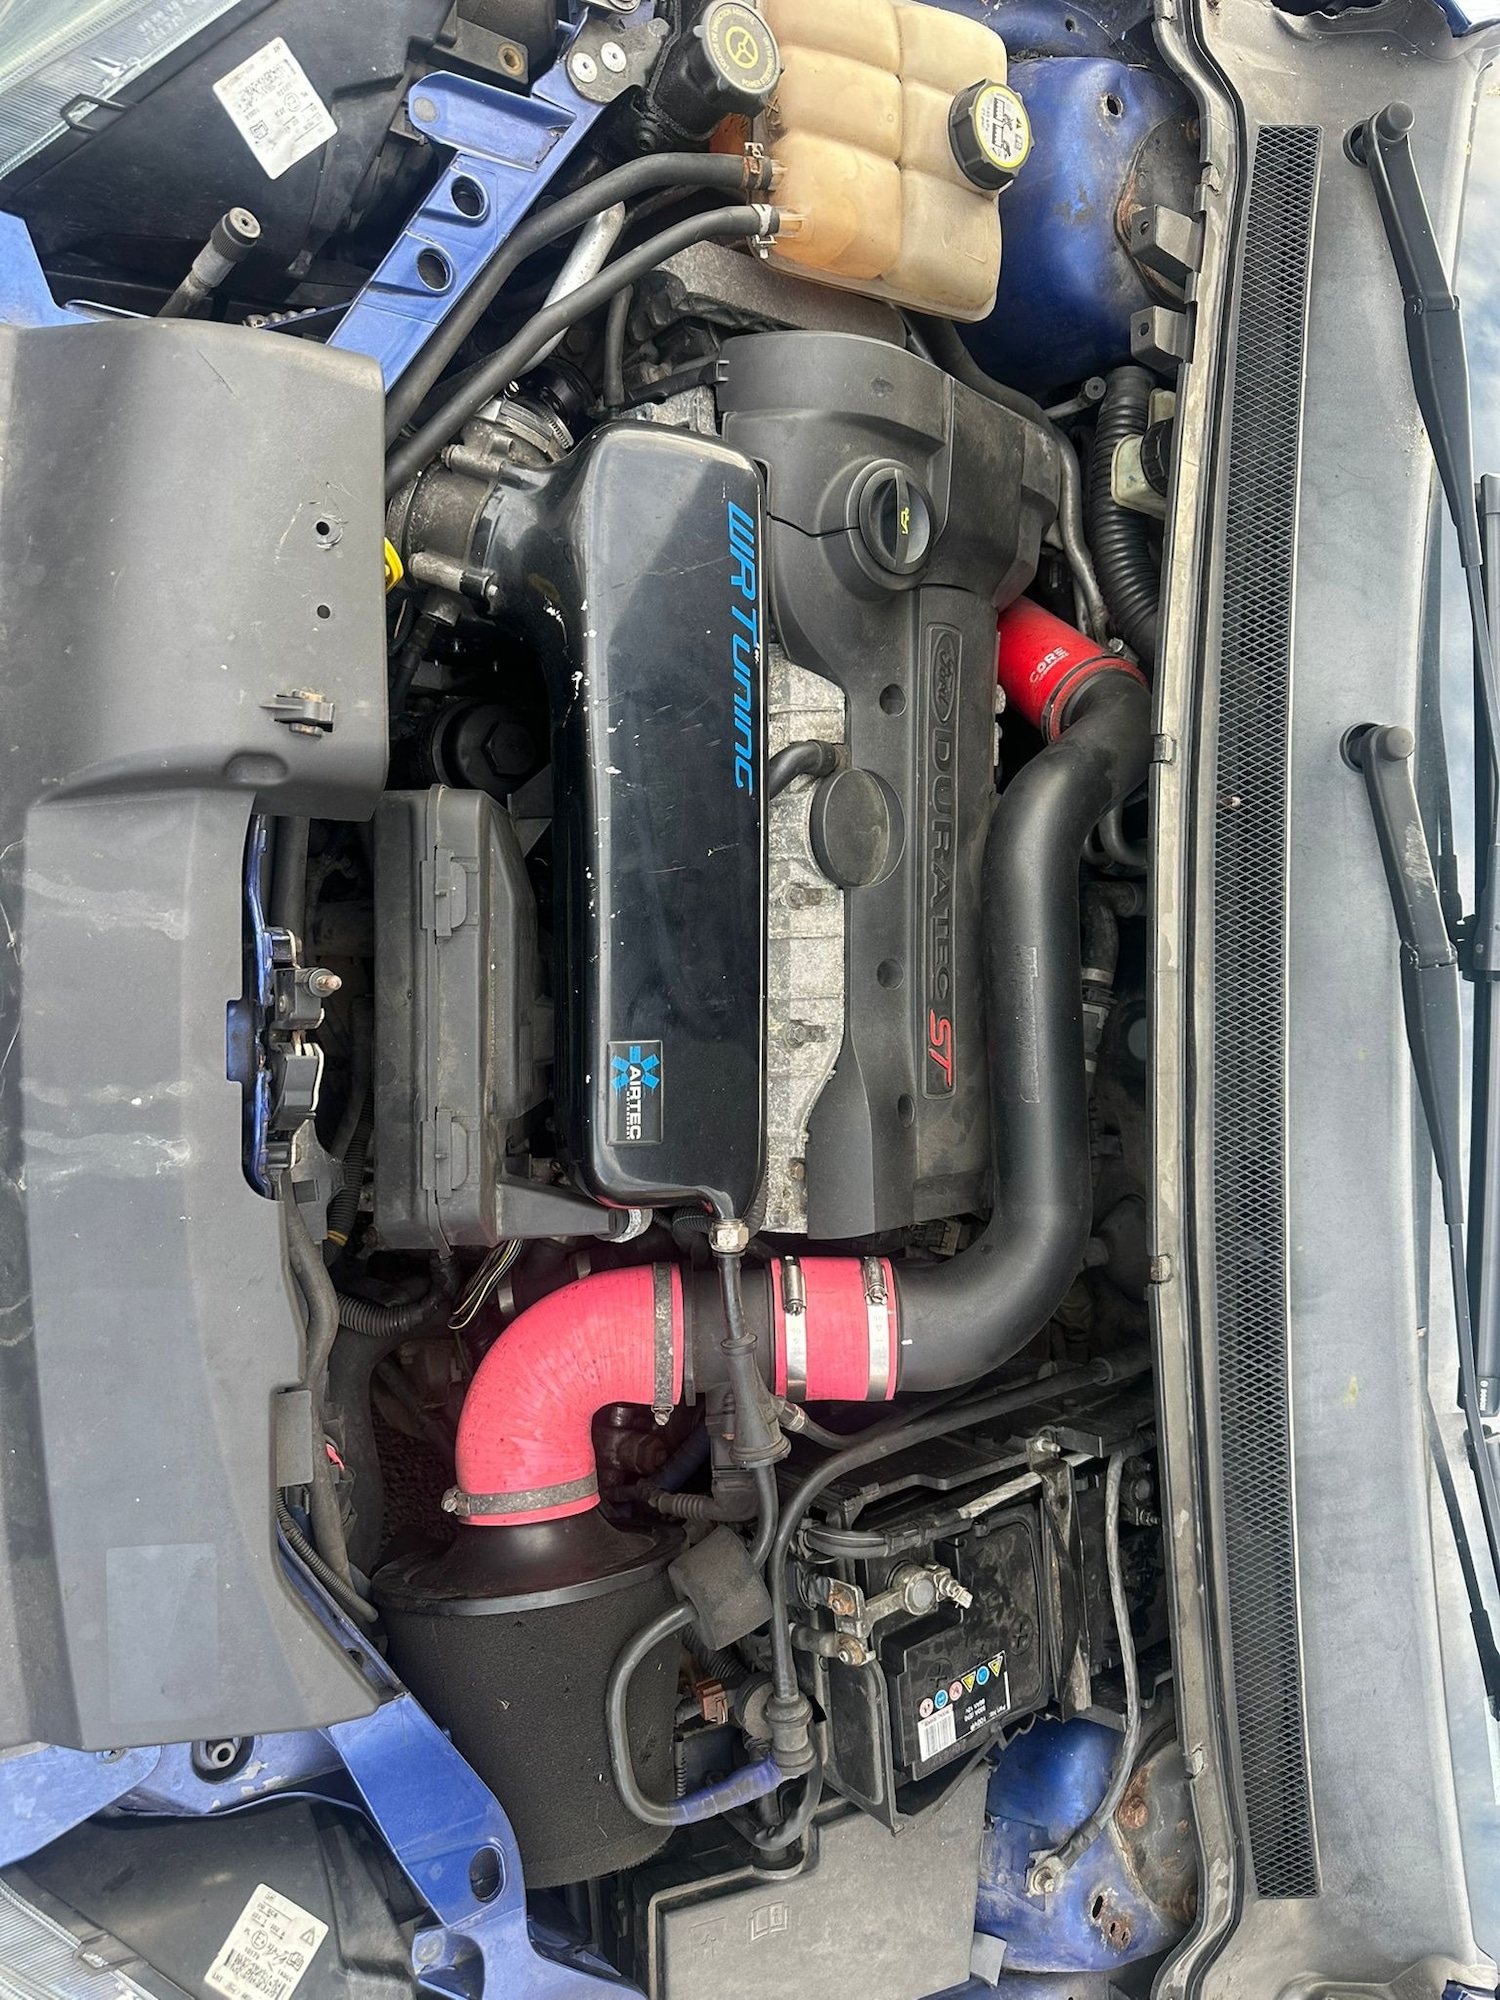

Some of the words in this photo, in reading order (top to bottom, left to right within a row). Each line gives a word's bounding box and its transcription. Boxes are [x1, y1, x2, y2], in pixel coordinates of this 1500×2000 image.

[728, 501, 756, 600] WR
[1029, 646, 1065, 683] CORE
[931, 727, 953, 1001] DURATEC
[929, 1007, 953, 1086] ST
[629, 1064, 642, 1141] AIRTEC
